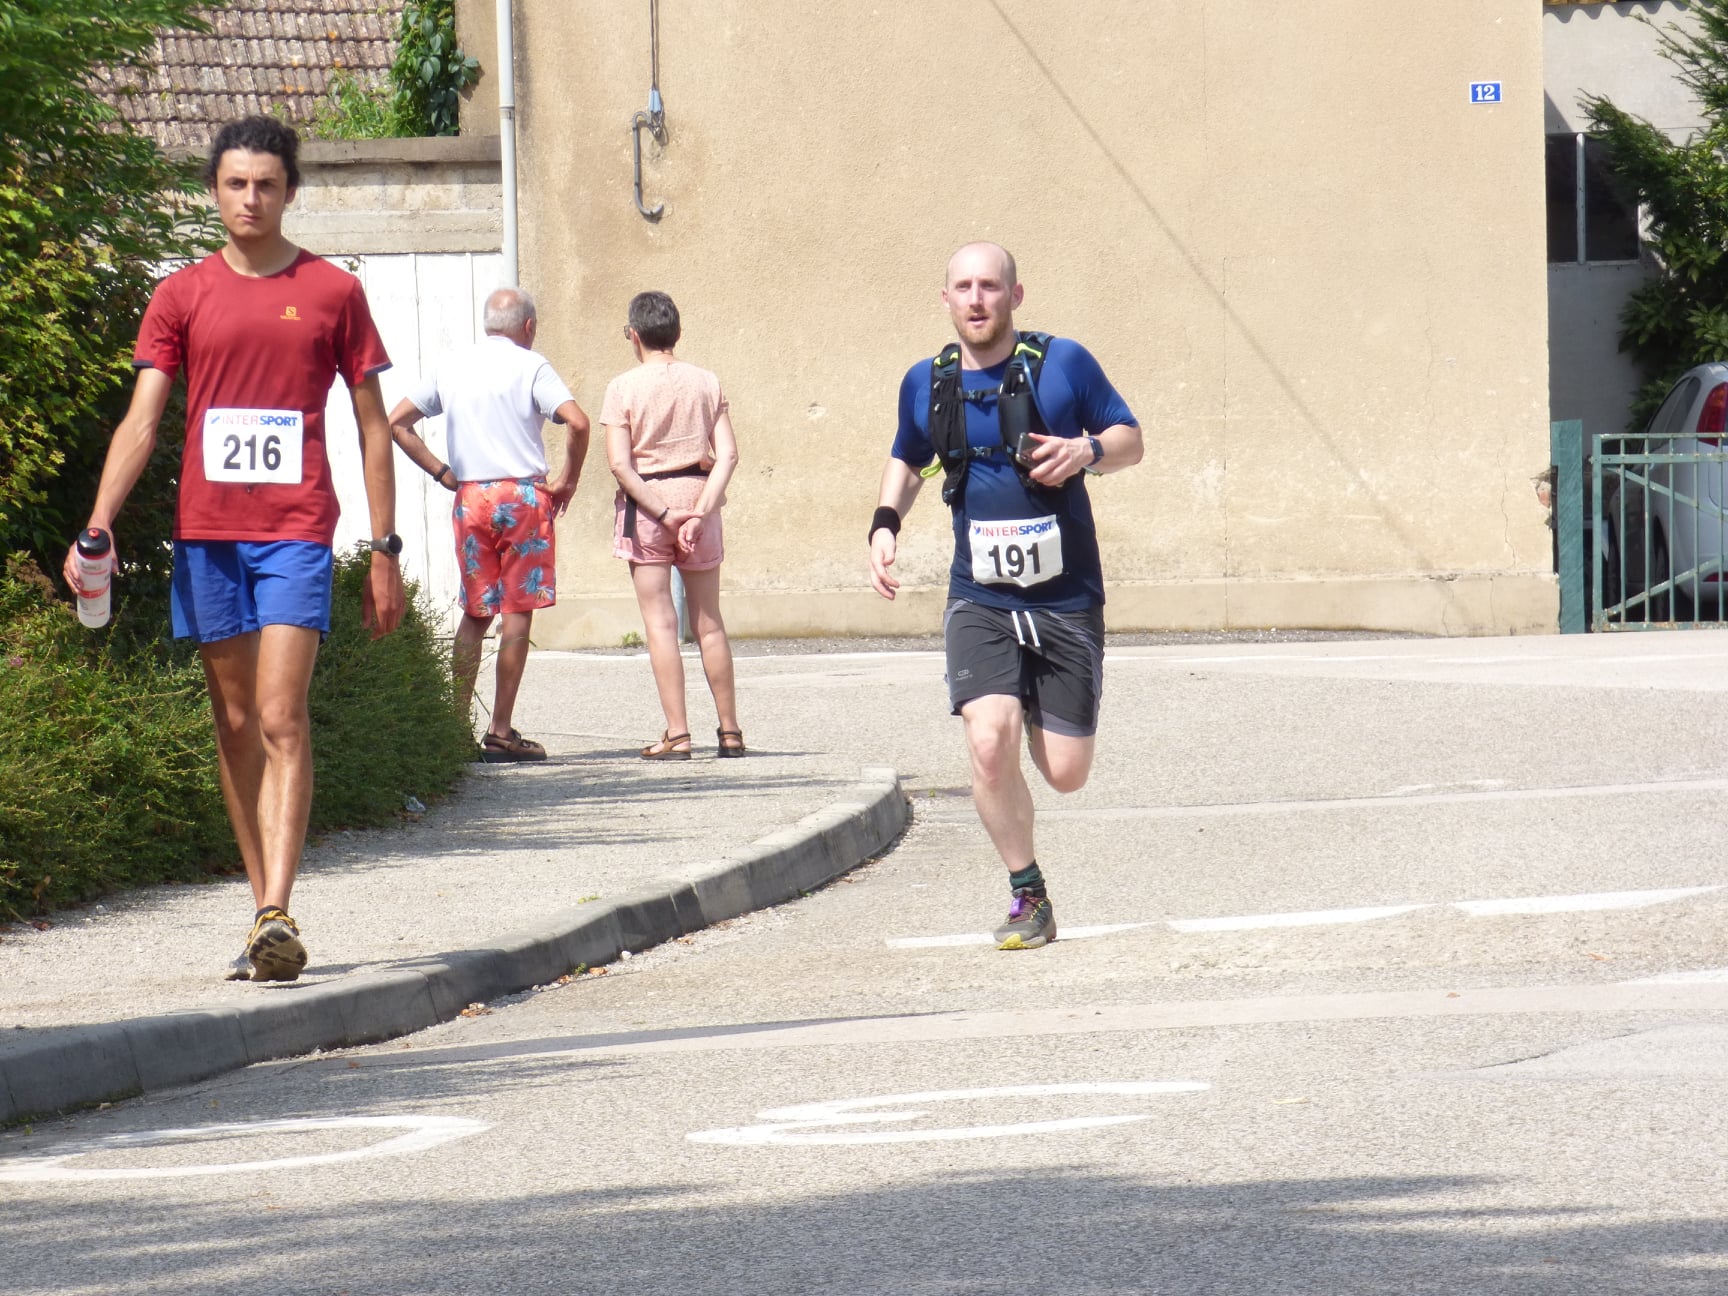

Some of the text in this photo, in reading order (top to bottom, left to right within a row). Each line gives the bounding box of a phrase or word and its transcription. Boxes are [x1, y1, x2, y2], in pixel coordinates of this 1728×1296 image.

[1475, 85, 1495, 101] 12
[222, 415, 298, 427] INTERSPORT
[223, 434, 281, 471] 216
[981, 521, 1053, 537] INTERSPORT
[987, 542, 1041, 578] 191
